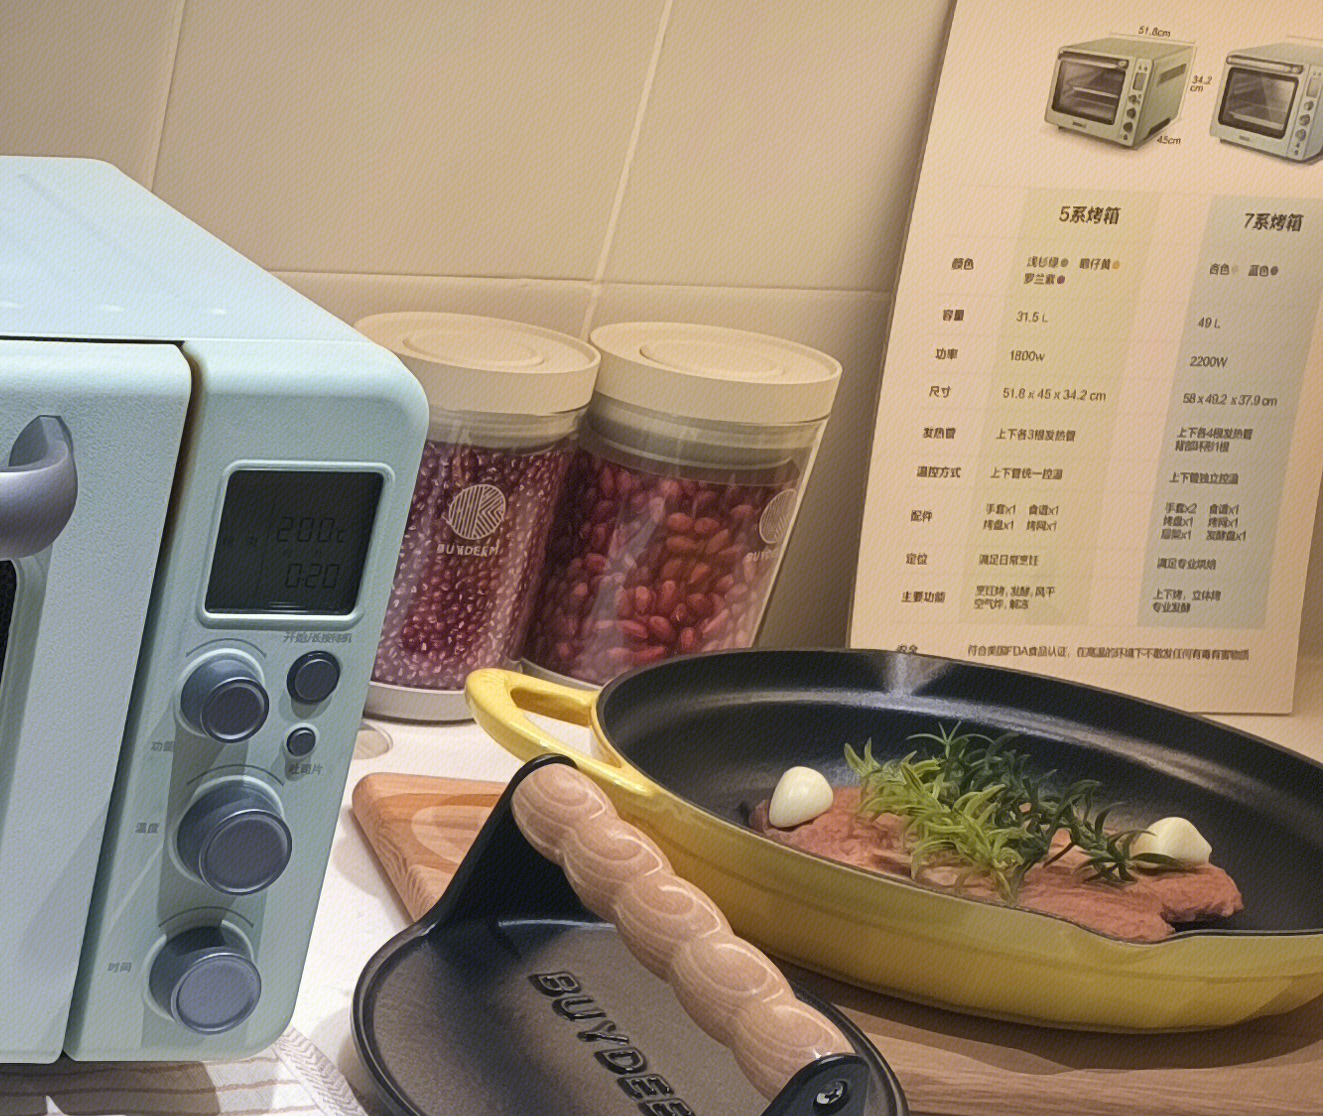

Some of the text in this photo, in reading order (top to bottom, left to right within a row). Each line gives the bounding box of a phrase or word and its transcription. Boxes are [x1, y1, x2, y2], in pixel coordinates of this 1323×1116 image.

[1058, 205, 1122, 226] 5系烤箱
[1243, 212, 1305, 233] 7系烤箱
[951, 257, 975, 271] 颜色
[942, 308, 966, 322] 容量
[934, 347, 959, 361] 功率
[1189, 355, 1228, 368] 2200W
[928, 385, 952, 399] 尺寸
[916, 465, 962, 479] 温控方式
[910, 508, 933, 523] 配件
